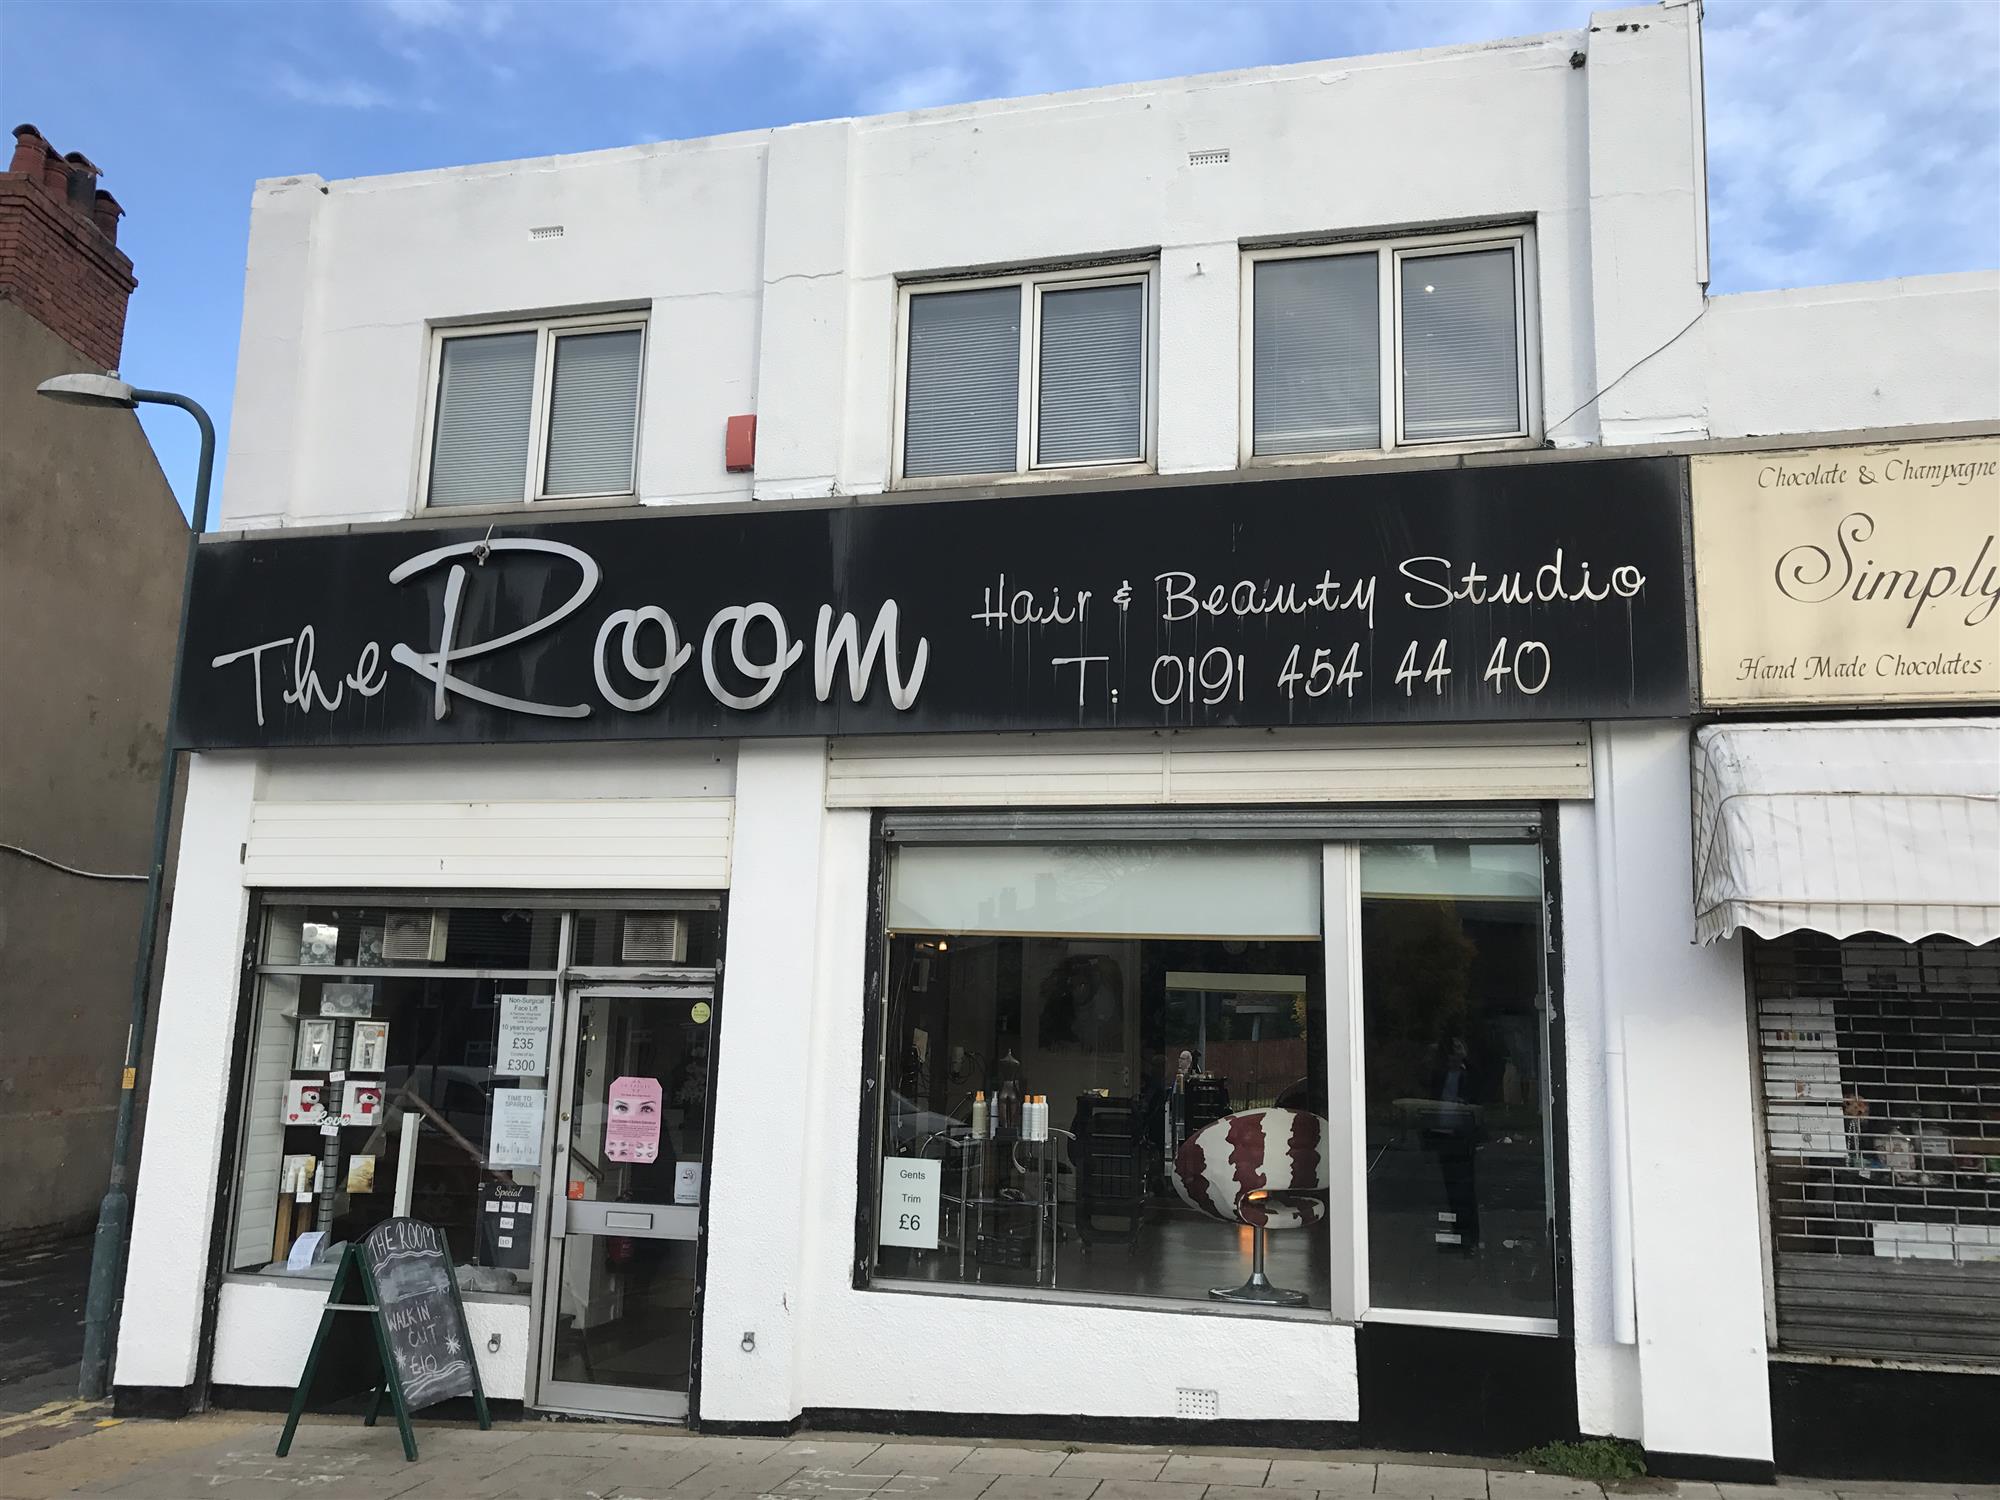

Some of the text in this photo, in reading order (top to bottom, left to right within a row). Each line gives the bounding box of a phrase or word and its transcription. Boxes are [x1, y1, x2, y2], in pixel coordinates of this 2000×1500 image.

[1758, 459, 1997, 488] Chocolate & Champagne
[1775, 512, 2000, 629] Simply
[971, 548, 1646, 630] Hair & Beauty Studio
[212, 537, 929, 727] The Room
[1052, 636, 1551, 706] T: 0191 454 44 40
[1736, 652, 1983, 681] Hand Made Chocolates
[508, 997, 545, 1005] Non-Surgical
[512, 1037, 534, 1050] £35
[507, 1059, 536, 1072] £300
[900, 1169, 926, 1180] Gents
[494, 1185, 523, 1199] Special
[902, 1193, 921, 1204] Trim
[899, 1213, 920, 1231] £6
[368, 1221, 438, 1261] THE ROOM
[385, 1311, 417, 1333] WALK
[408, 1324, 437, 1348] CUT
[410, 1354, 438, 1375] £10
